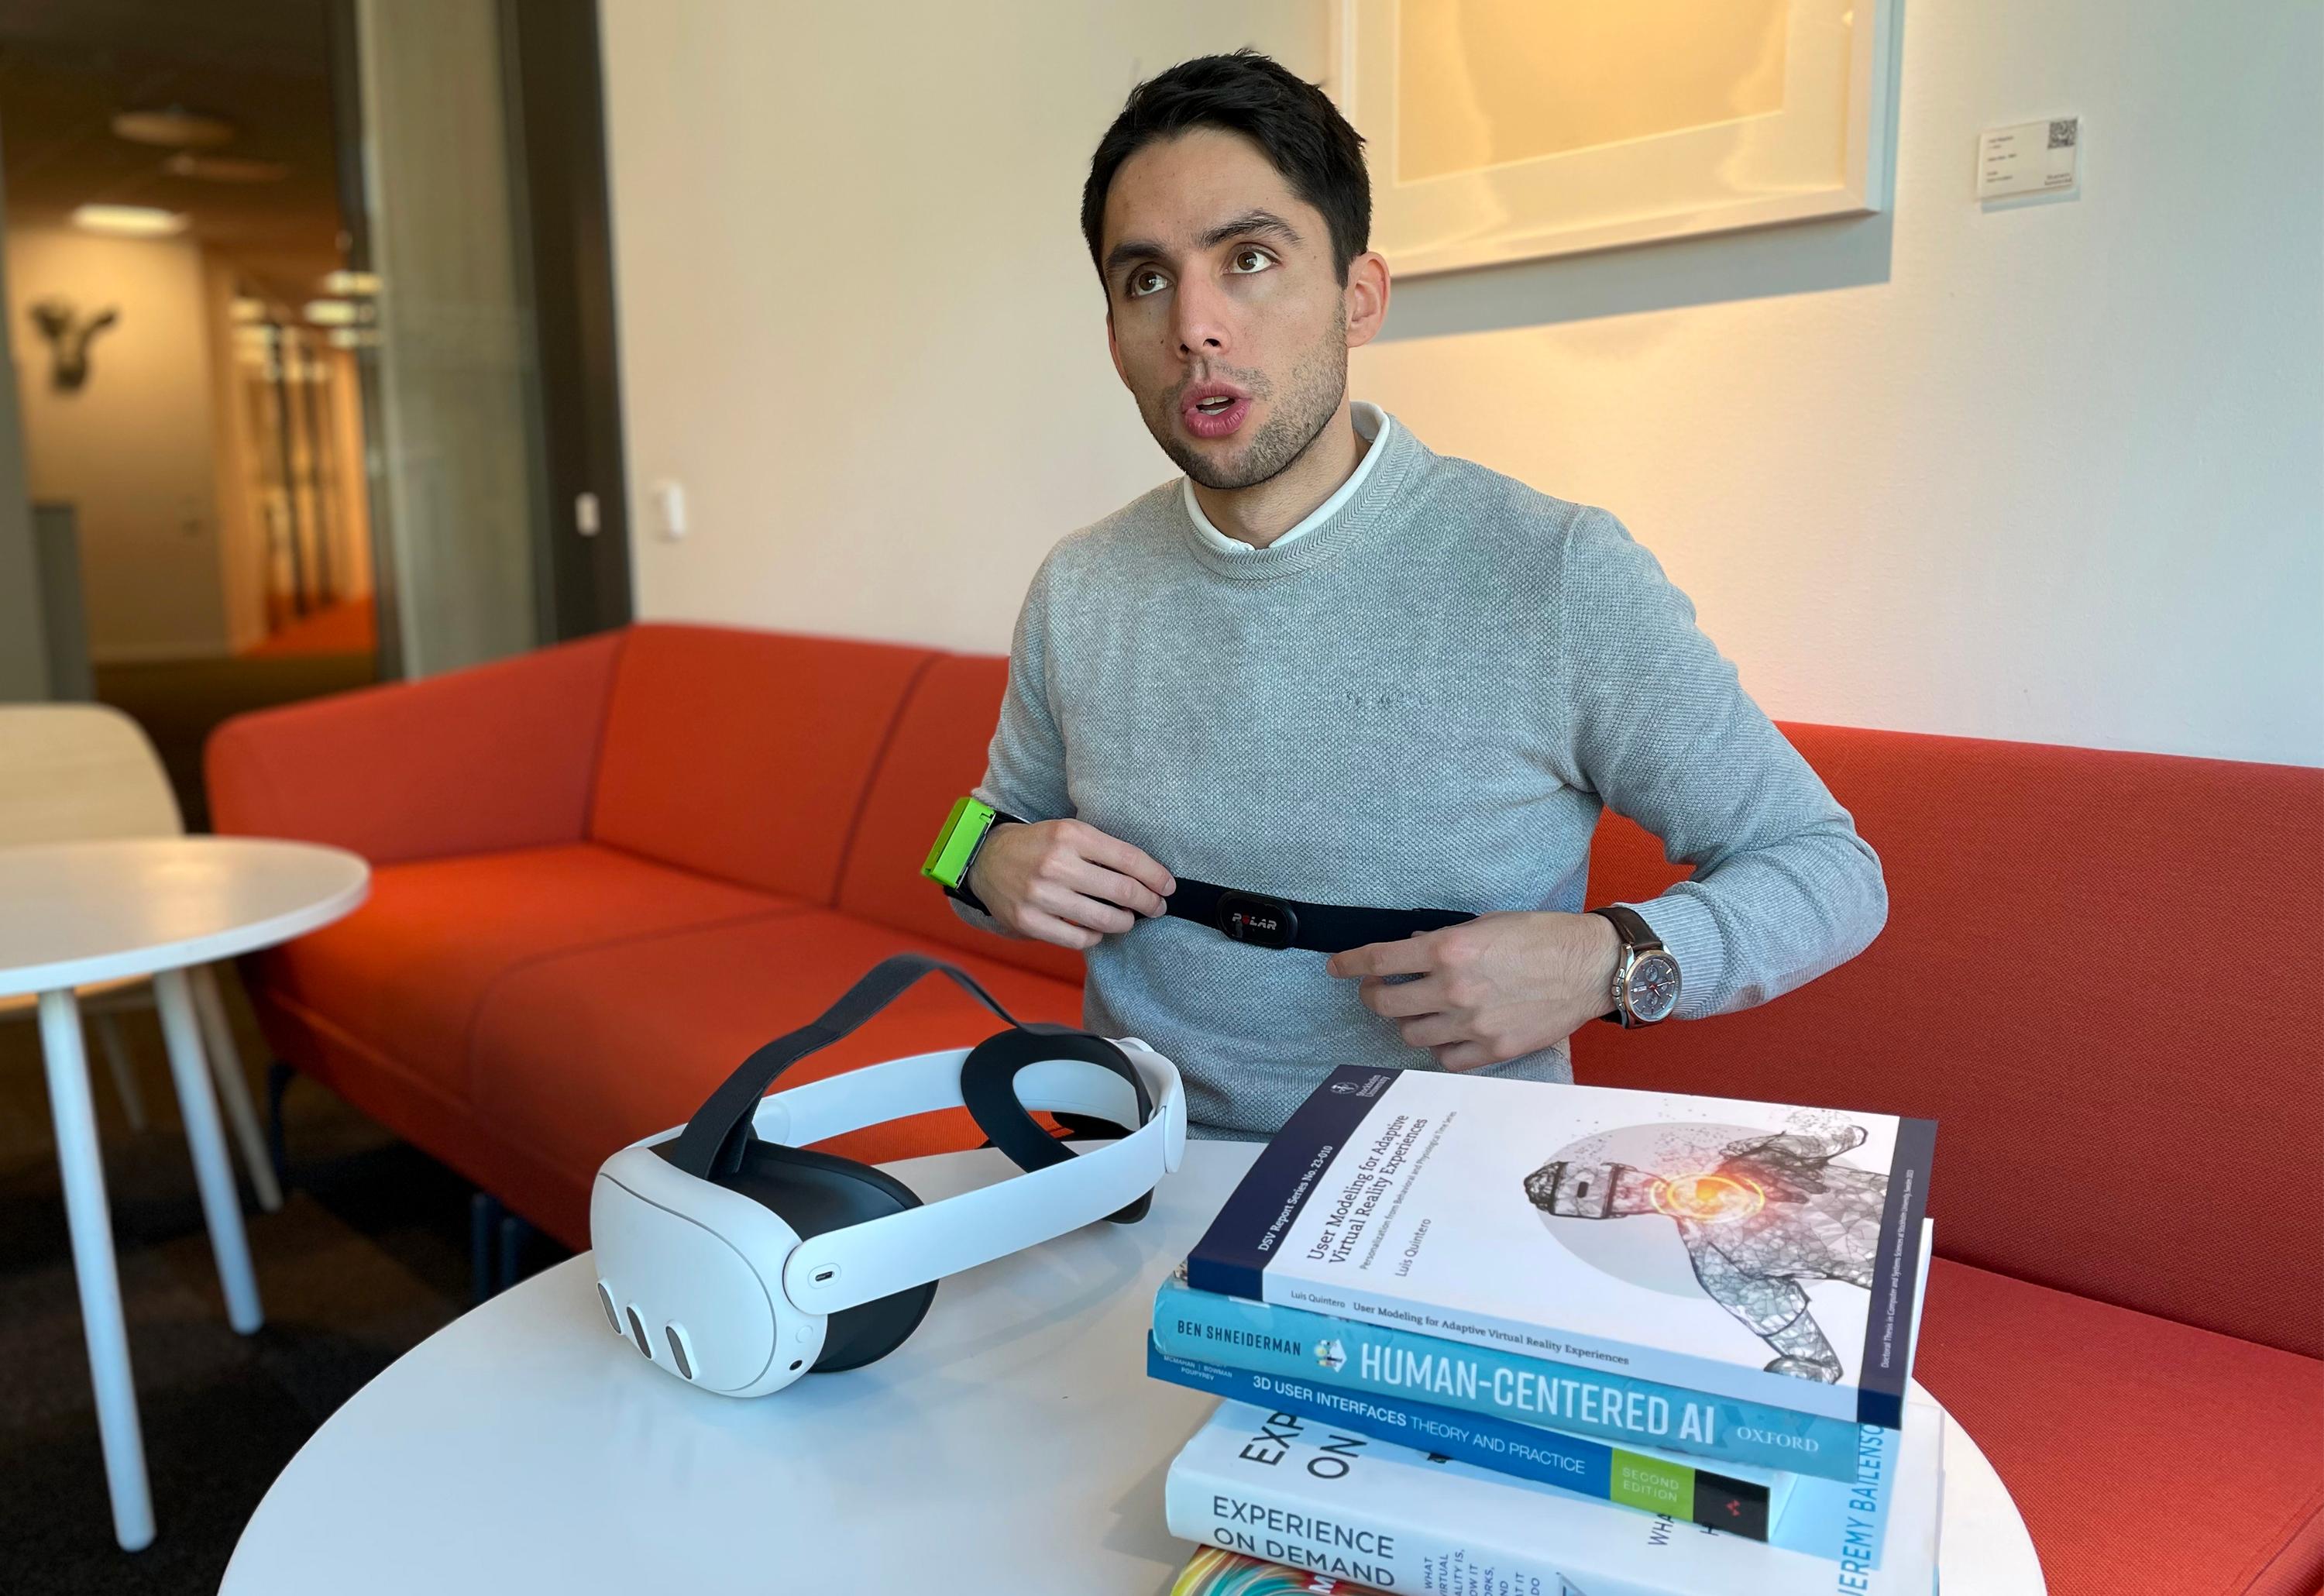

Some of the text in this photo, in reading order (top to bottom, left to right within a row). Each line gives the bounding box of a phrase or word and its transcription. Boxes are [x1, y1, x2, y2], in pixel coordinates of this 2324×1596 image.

[1258, 1145, 1333, 1251] DSV Report Series No. 23-010
[1307, 1115, 1409, 1260] User Modeling for Adaptive
[1329, 1119, 1428, 1263] Virtual Reality Experiences
[1359, 1218, 1391, 1270] Personalization
[1384, 1203, 1399, 1220] from
[1411, 1164, 1422, 1175] and
[1395, 1218, 1432, 1278] Luis Quintero
[1887, 1288, 1898, 1316] Computer
[1177, 1319, 1301, 1357] BEN SHNEIDERMAN
[1291, 1291, 1630, 1364] Luis Quintero User Modeling for Adaptive Virtual Reality Experiences
[1884, 1323, 1893, 1342] Thesis
[1204, 1366, 1232, 1378] BOWMAN
[1881, 1342, 1891, 1368] Doctoral
[1361, 1343, 1714, 1444] HUMAN-CENTERED AI
[1253, 1375, 1586, 1474] 3D USER INTERFACES THEORY AND PRACTICE
[1737, 1426, 1819, 1453] OXFORD
[1307, 1434, 1367, 1479] ON
[1622, 1467, 1679, 1490] SECOND
[1623, 1480, 1679, 1503] EDITION
[1213, 1495, 1394, 1560] EXPERIENCE
[1214, 1527, 1394, 1587] ON DEMAND
[1469, 1563, 1478, 1575] IT
[1515, 1572, 1525, 1584] IT
